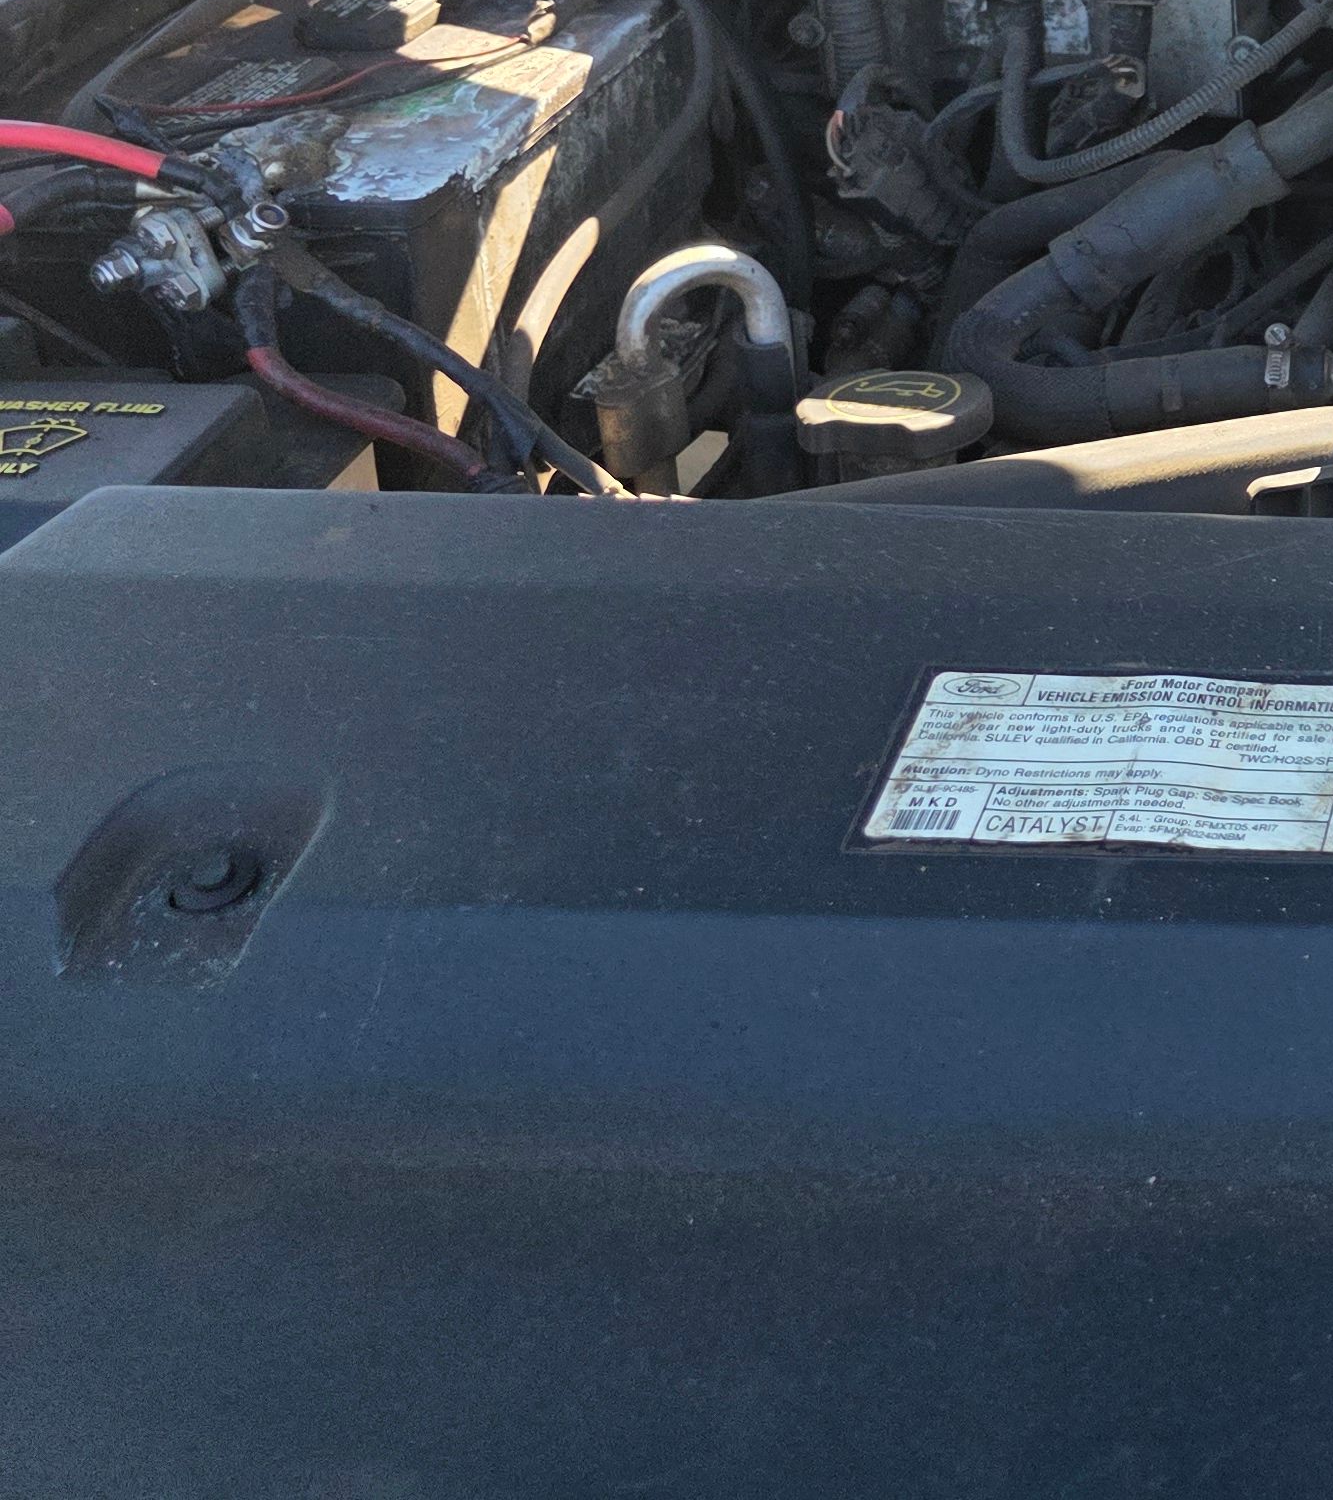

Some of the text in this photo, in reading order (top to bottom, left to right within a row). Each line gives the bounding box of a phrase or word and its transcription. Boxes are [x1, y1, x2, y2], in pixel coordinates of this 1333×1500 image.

[93, 402, 165, 413] FLUID
[957, 679, 1003, 694] Ford
[1127, 679, 1271, 698] Ford Motor Company
[1038, 691, 1101, 703] VEHICLE
[1102, 691, 1173, 703] EMISSION
[1177, 693, 1244, 708] CONTROL
[929, 709, 954, 718] This
[959, 711, 1004, 720] vehicle
[1009, 713, 1069, 722] conforms
[1073, 714, 1085, 723] to
[1091, 714, 1116, 723] U.S.
[1123, 713, 1150, 722] EPA
[1153, 714, 1224, 726] regulations
[1230, 720, 1294, 732] applicable
[922, 722, 964, 730] model
[969, 723, 1000, 733] year
[1042, 724, 1104, 735] light-duty
[1112, 725, 1152, 733] trucks
[1159, 725, 1186, 733] and
[1210, 728, 1266, 741] certified
[1273, 732, 1291, 742] for
[1297, 734, 1326, 743] sale
[918, 730, 980, 742] California.
[984, 733, 1033, 743] SULEV
[1035, 734, 1090, 744] qualified
[1107, 734, 1169, 745] California.
[1174, 735, 1205, 746] OBD
[1226, 740, 1279, 753] certified.
[902, 764, 1163, 779] Attention: Dyno Restrictions may apply.
[992, 797, 1186, 810] No other adjustments needed.
[996, 786, 1090, 797] Adjustments:
[1094, 787, 1131, 797] Spark
[1135, 786, 1164, 798] Plug
[1168, 788, 1199, 800] Gap:
[1202, 792, 1228, 803] See
[1232, 795, 1265, 806] Spec
[985, 816, 1105, 834] CATALYST
[1115, 824, 1146, 833] Evap:
[1118, 814, 1142, 823] 5.4L
[1154, 815, 1192, 826] Group:
